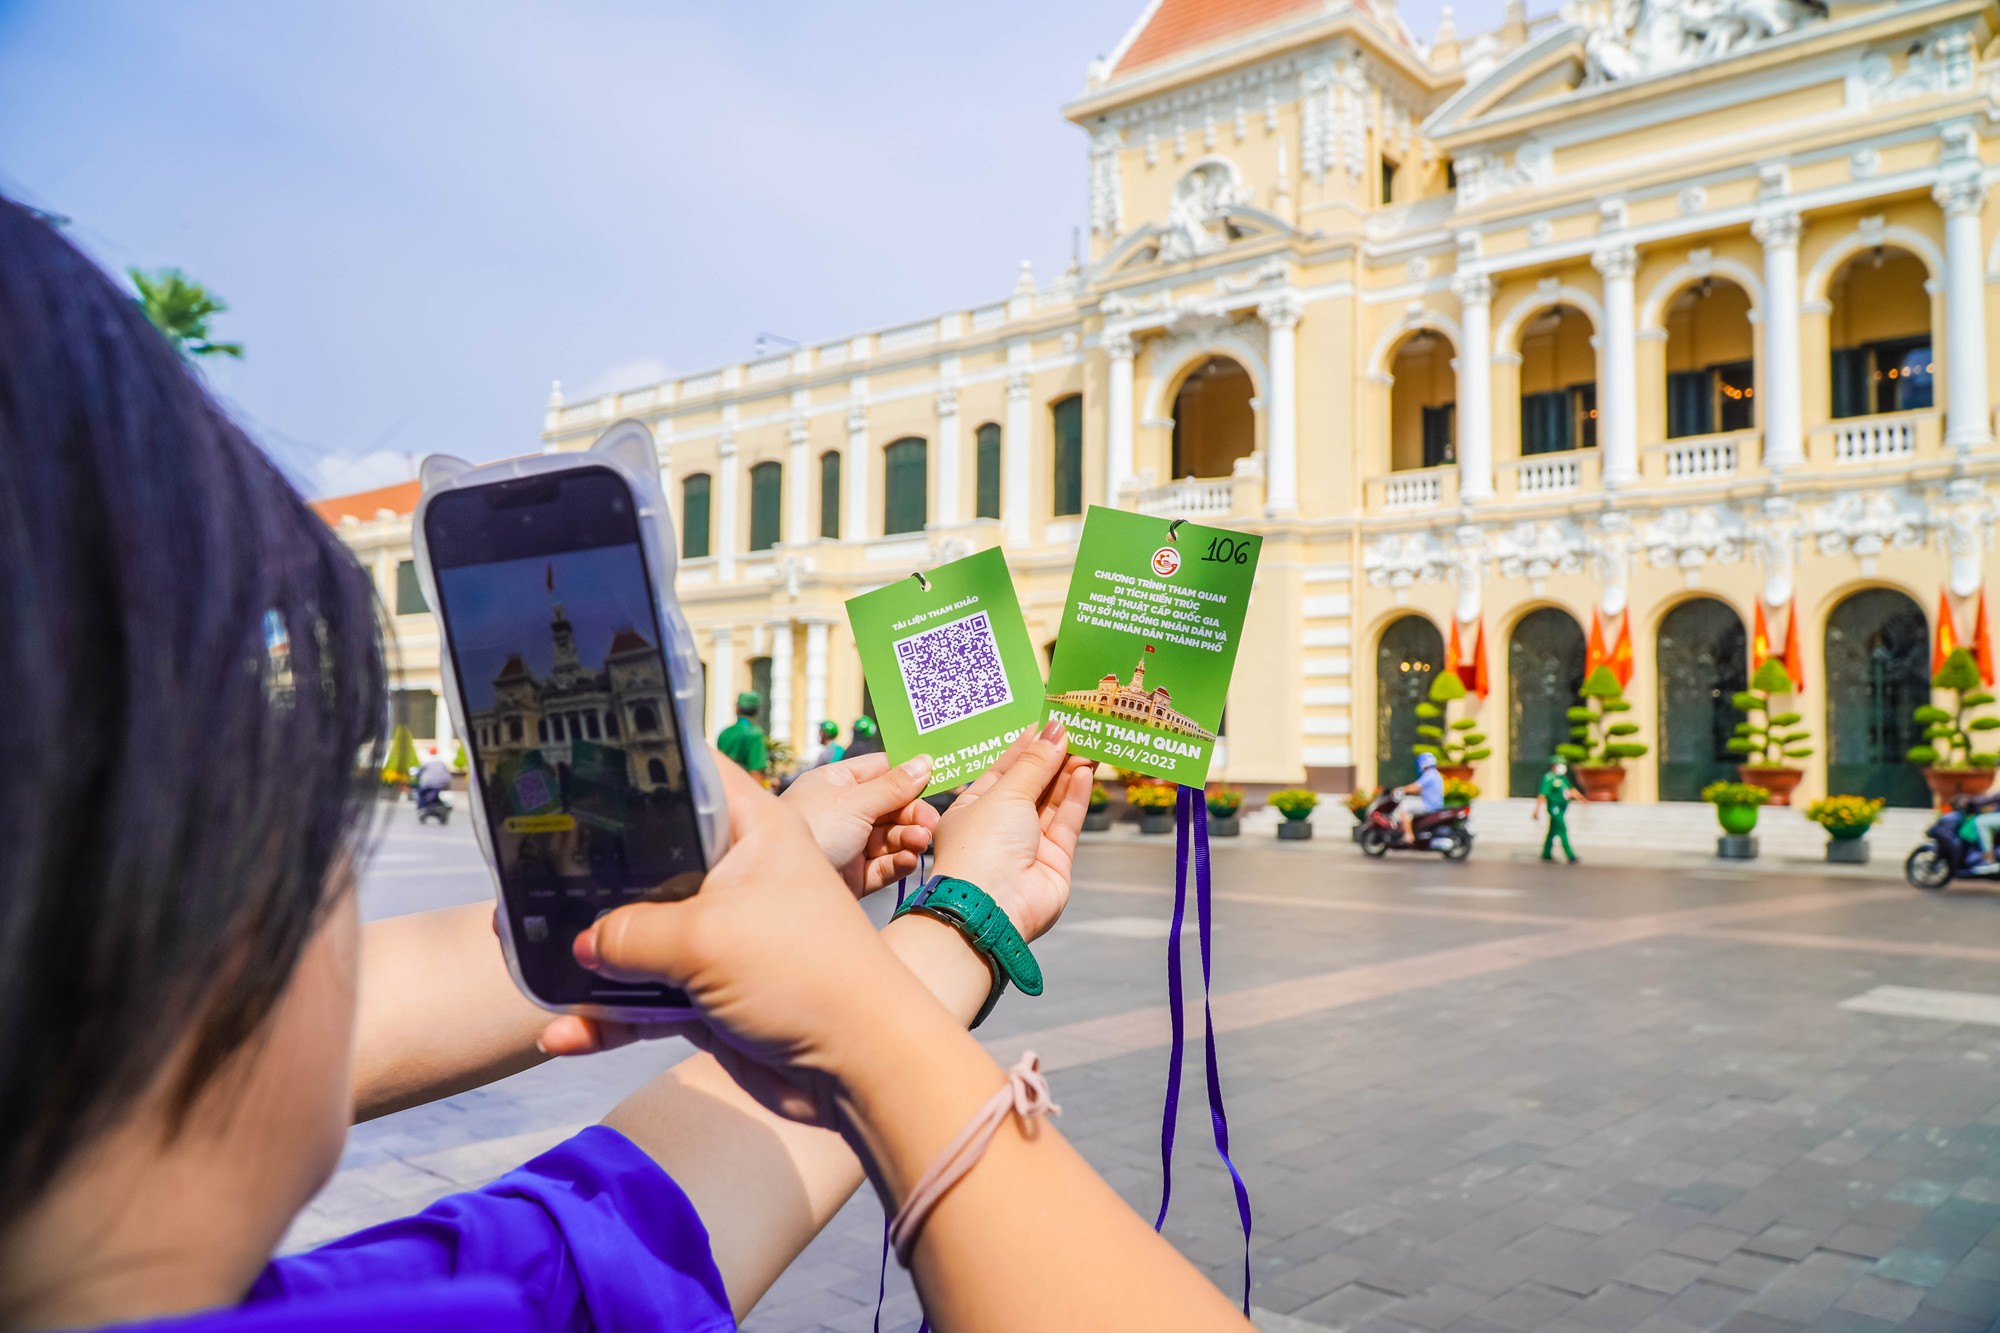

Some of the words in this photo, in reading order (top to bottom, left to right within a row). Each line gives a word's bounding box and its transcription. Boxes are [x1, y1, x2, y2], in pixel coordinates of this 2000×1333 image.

[1201, 537, 1250, 564] 106
[1094, 569, 1135, 585] CHƯƠNG
[1137, 578, 1166, 592] TRÌNH
[1168, 584, 1197, 597] THAM
[1198, 591, 1227, 604] QUAN
[1114, 585, 1125, 595] DI
[1126, 587, 1148, 600] TÍCH
[1149, 592, 1173, 605] KIẾN
[1174, 598, 1200, 611] TRÚC
[892, 621, 907, 631] TÀI
[907, 614, 927, 626] LIỆU
[927, 604, 953, 618] THAM
[953, 595, 979, 609] KHẢO
[1078, 601, 1097, 614] TRỤ
[1097, 604, 1112, 616] SỞ
[1112, 609, 1130, 621] HỘI
[1160, 620, 1190, 633] NHÂN
[1191, 626, 1213, 638] DÂN
[1214, 630, 1227, 642] VÀ
[1089, 592, 1117, 607] NGHỆ
[1118, 598, 1150, 612] THUẬT
[1150, 604, 1171, 616] CẤP
[1172, 610, 1201, 623] QUỐC
[1202, 616, 1220, 627] GIA
[1076, 611, 1091, 623] ỦY
[1091, 616, 1112, 628] BAN
[1113, 621, 1141, 635] NHÂN
[1142, 627, 1164, 640] DÂN
[1165, 633, 1200, 648] THÀNH
[1201, 641, 1225, 653] PHỐ
[957, 736, 1002, 760] THAM
[1048, 709, 1102, 734] KHÁCH
[1105, 723, 1151, 747] THAM
[1152, 736, 1202, 760] QUAN
[1066, 730, 1102, 750] NGÀY
[1104, 741, 1177, 770] 29/4/2023
[965, 750, 1006, 773] 29/4/
